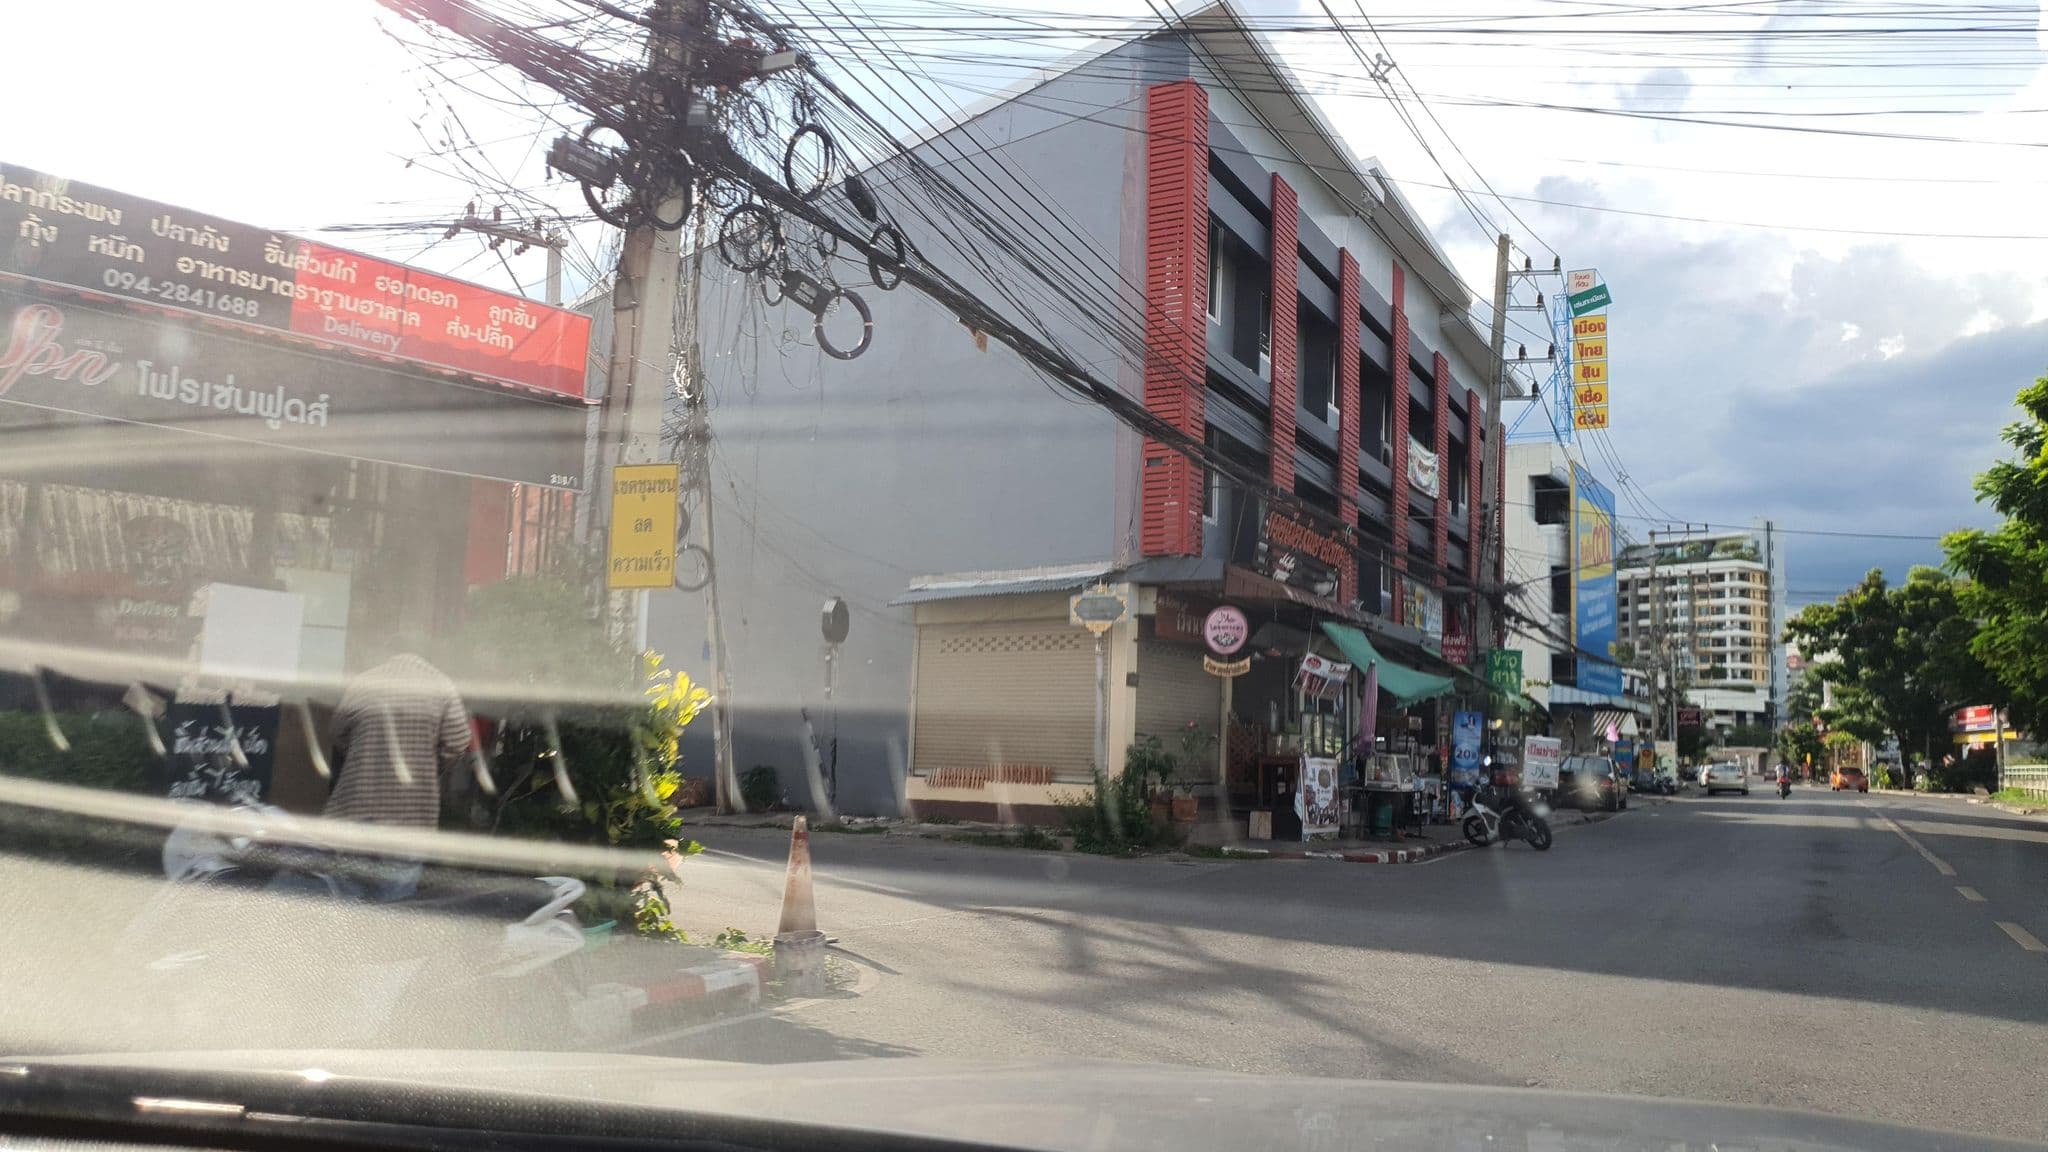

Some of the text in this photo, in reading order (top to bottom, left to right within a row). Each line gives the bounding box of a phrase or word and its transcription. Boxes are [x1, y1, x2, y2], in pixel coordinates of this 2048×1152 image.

[20, 213, 59, 248] กุ้ง
[103, 268, 260, 318] 094-2841688
[324, 315, 402, 352] Delivery
[136, 359, 328, 430] โฟรเซ่นฟูดส์
